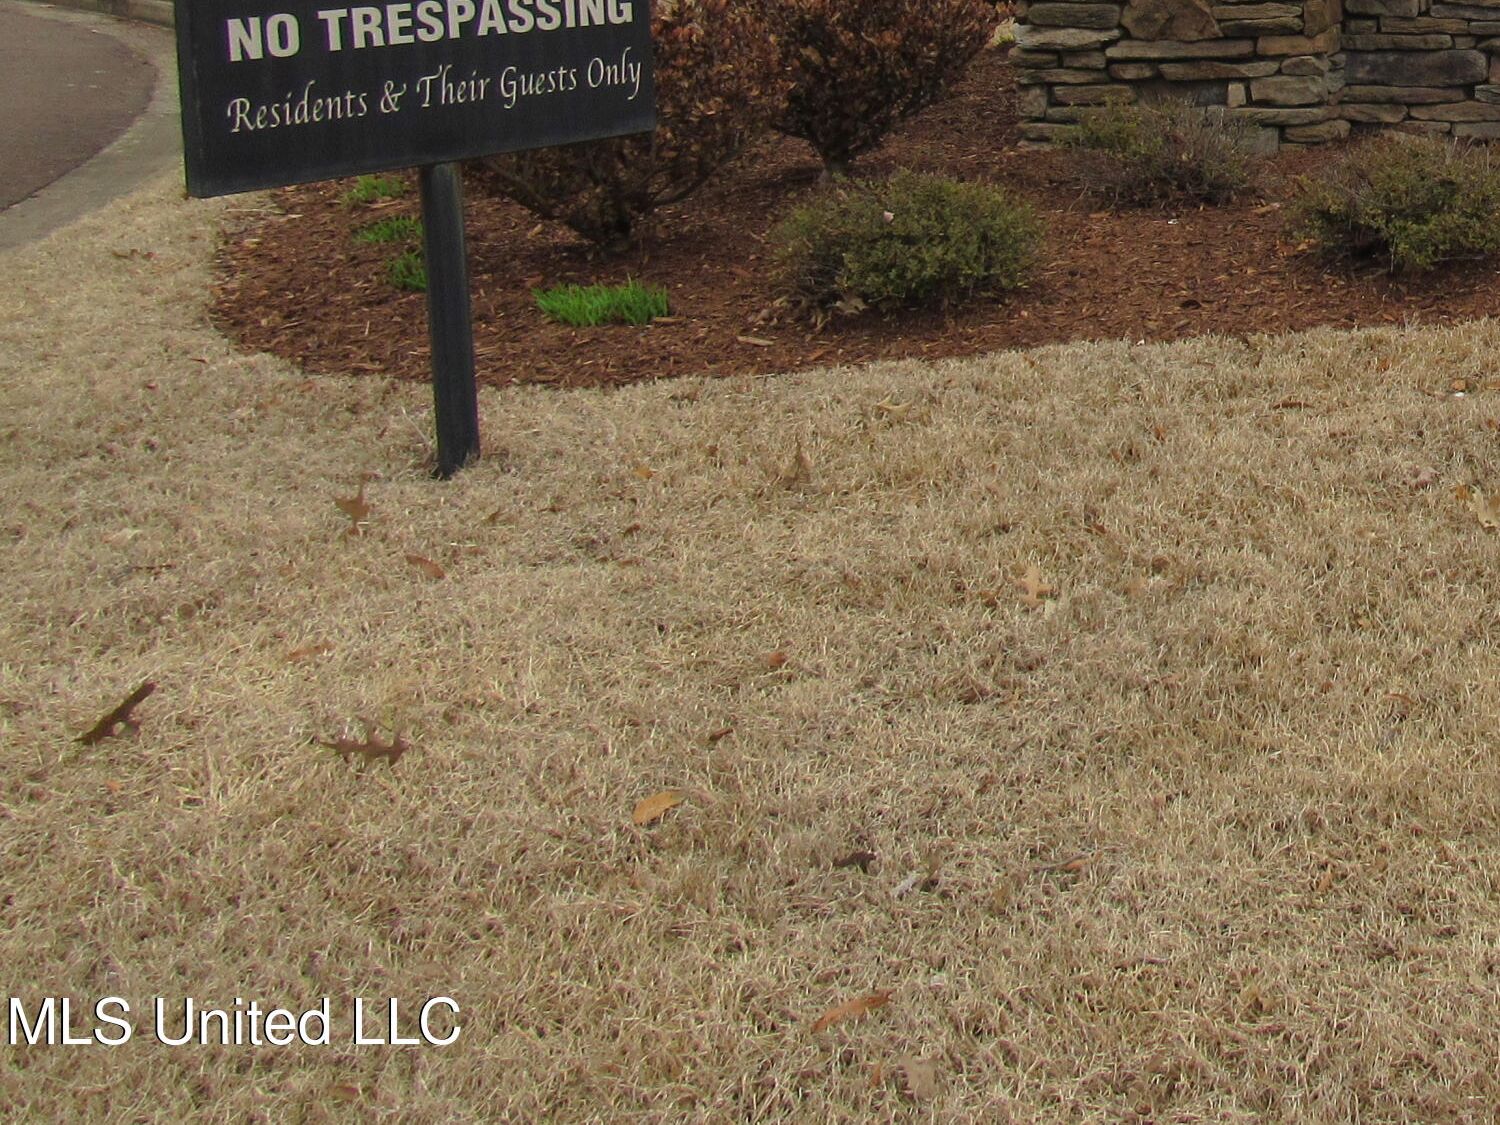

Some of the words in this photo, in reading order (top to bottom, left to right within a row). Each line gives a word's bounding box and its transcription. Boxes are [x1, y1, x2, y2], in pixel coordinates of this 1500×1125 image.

[227, 13, 301, 62] NO
[227, 80, 368, 133] Residents
[380, 80, 407, 115] &
[416, 64, 491, 109] Their
[501, 64, 578, 110] Guests
[587, 46, 643, 101] Only
